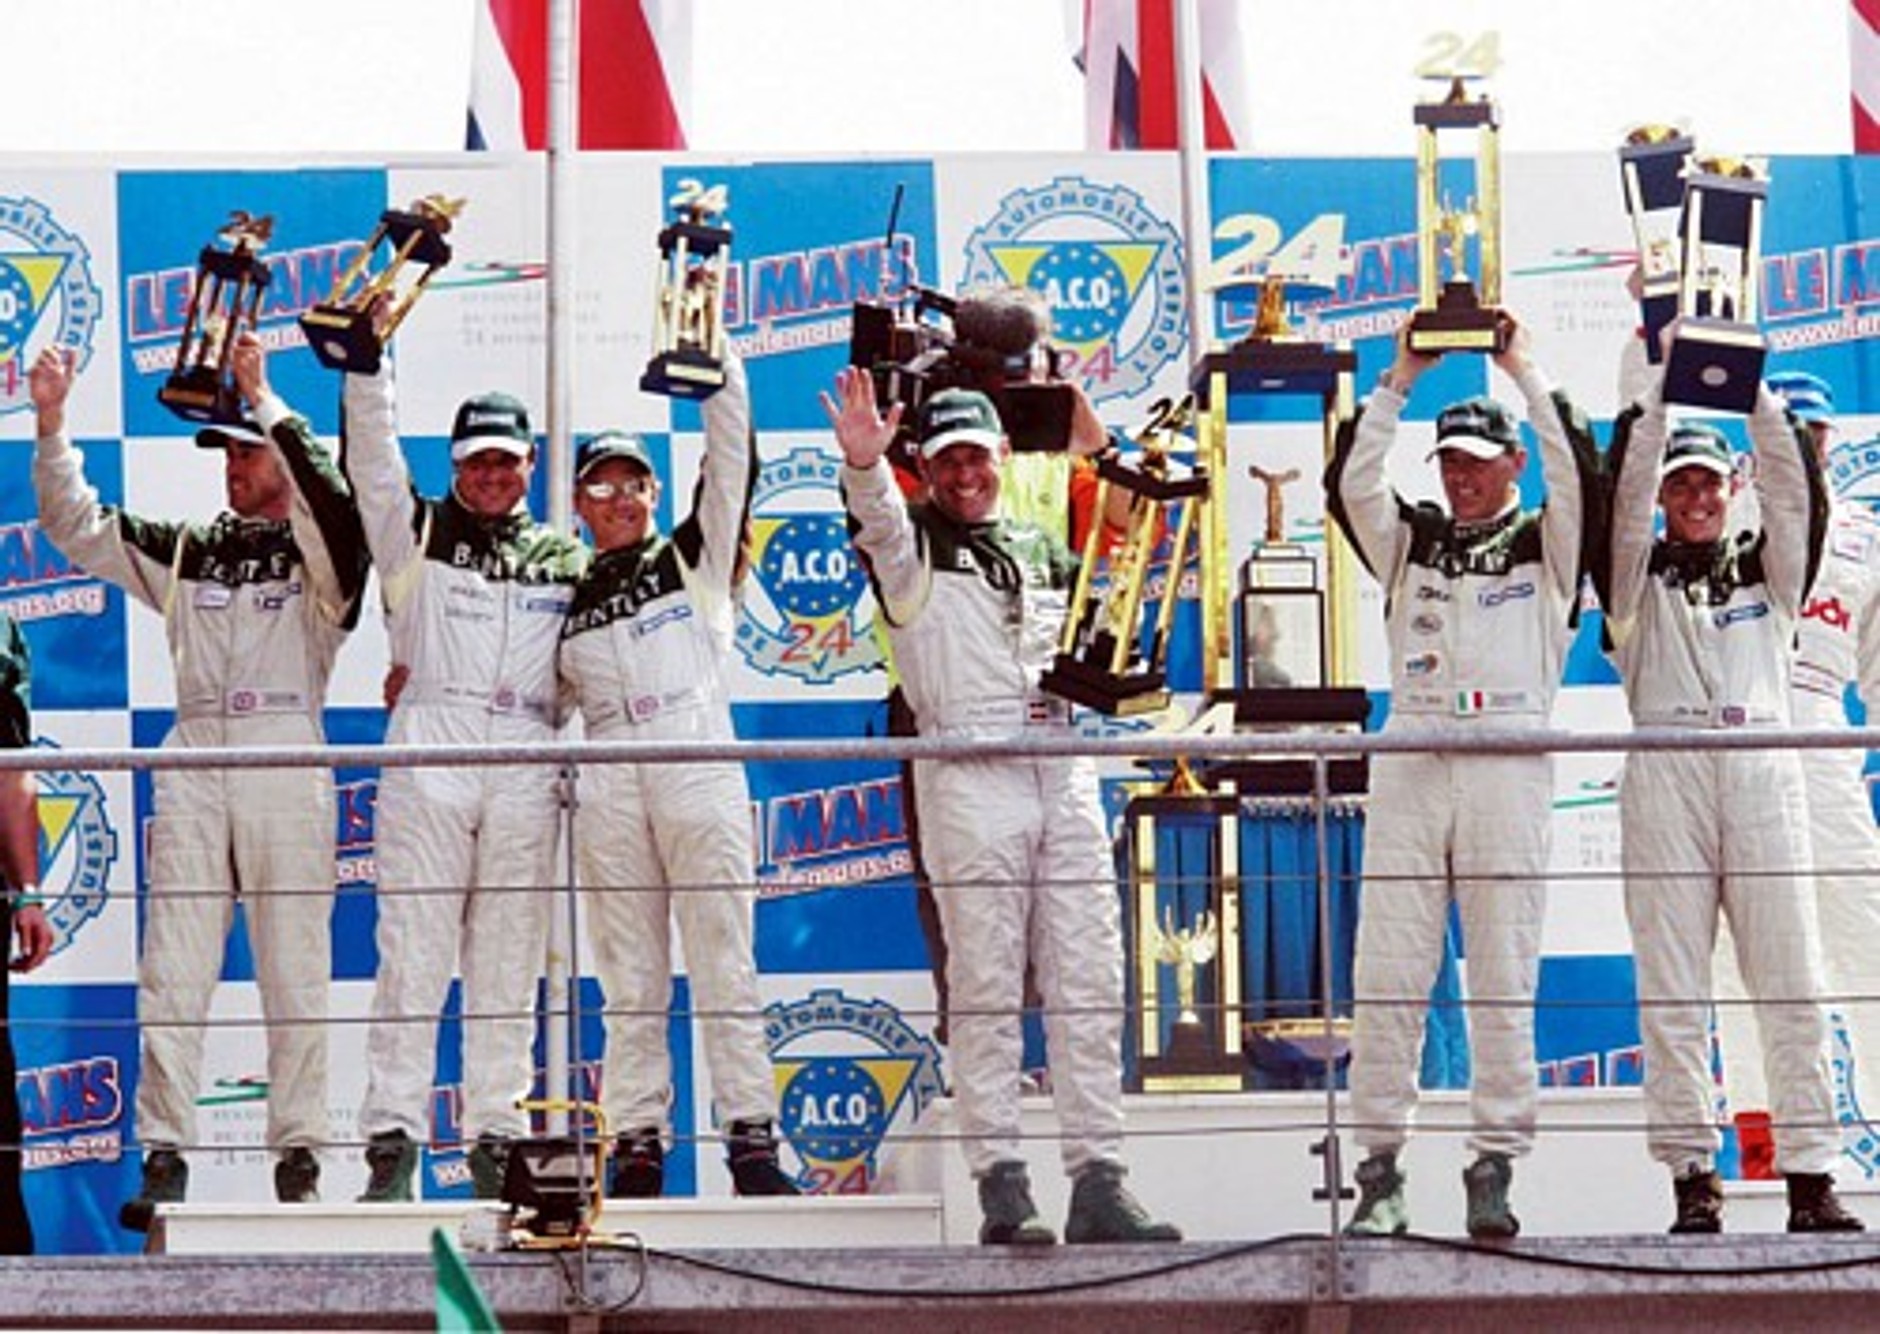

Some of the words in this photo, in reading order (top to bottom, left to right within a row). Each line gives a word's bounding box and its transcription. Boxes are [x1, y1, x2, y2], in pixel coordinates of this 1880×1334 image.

[1414, 30, 1500, 76] 24
[669, 180, 728, 212] 24
[998, 190, 1150, 236] AUTOMOBILE
[1203, 213, 1350, 284] 24
[780, 551, 848, 582] A.C.O
[780, 619, 855, 662] 24
[763, 1005, 908, 1049] UTOMOBILE
[801, 1093, 868, 1127] A.C.O
